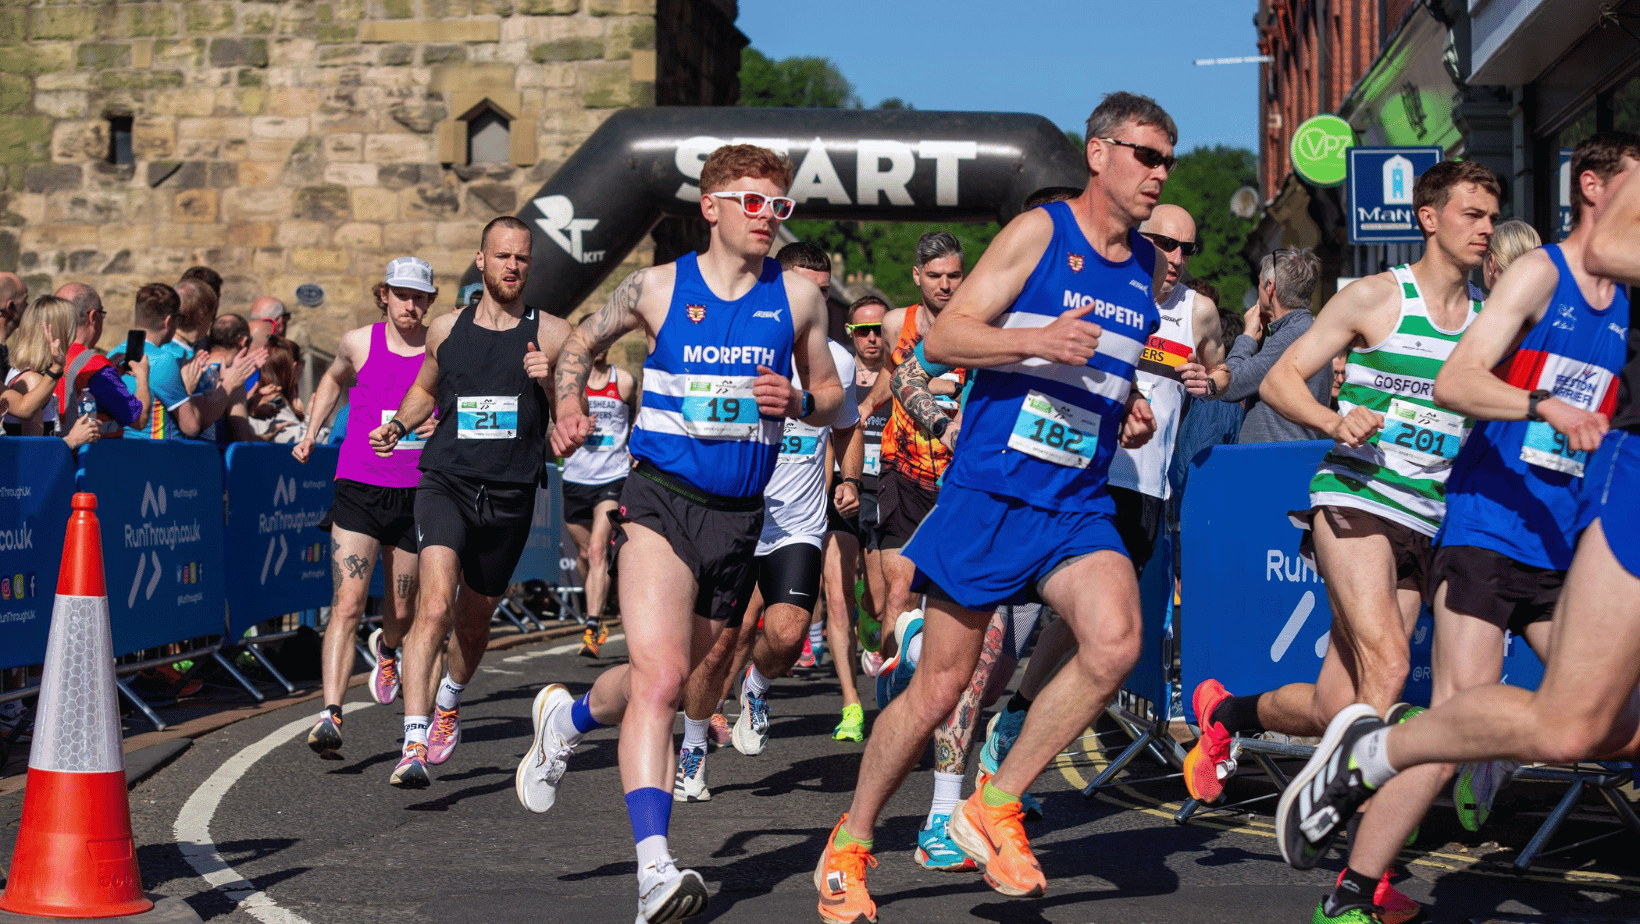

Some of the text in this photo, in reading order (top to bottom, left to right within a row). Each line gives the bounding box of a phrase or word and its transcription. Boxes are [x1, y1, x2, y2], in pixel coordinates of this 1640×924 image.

[1299, 128, 1353, 161] VPZ
[675, 136, 977, 206] SART
[582, 250, 606, 264] KIT
[1063, 290, 1145, 330] MORPETH
[683, 345, 775, 366] MORPETH
[1142, 348, 1165, 362] ERS
[588, 400, 616, 409] ESHEAD
[707, 398, 740, 422] 19
[475, 411, 500, 430] 21
[1029, 418, 1083, 454] 182
[1395, 422, 1446, 457] 201
[864, 456, 876, 470] 4
[1267, 550, 1325, 584] Run
